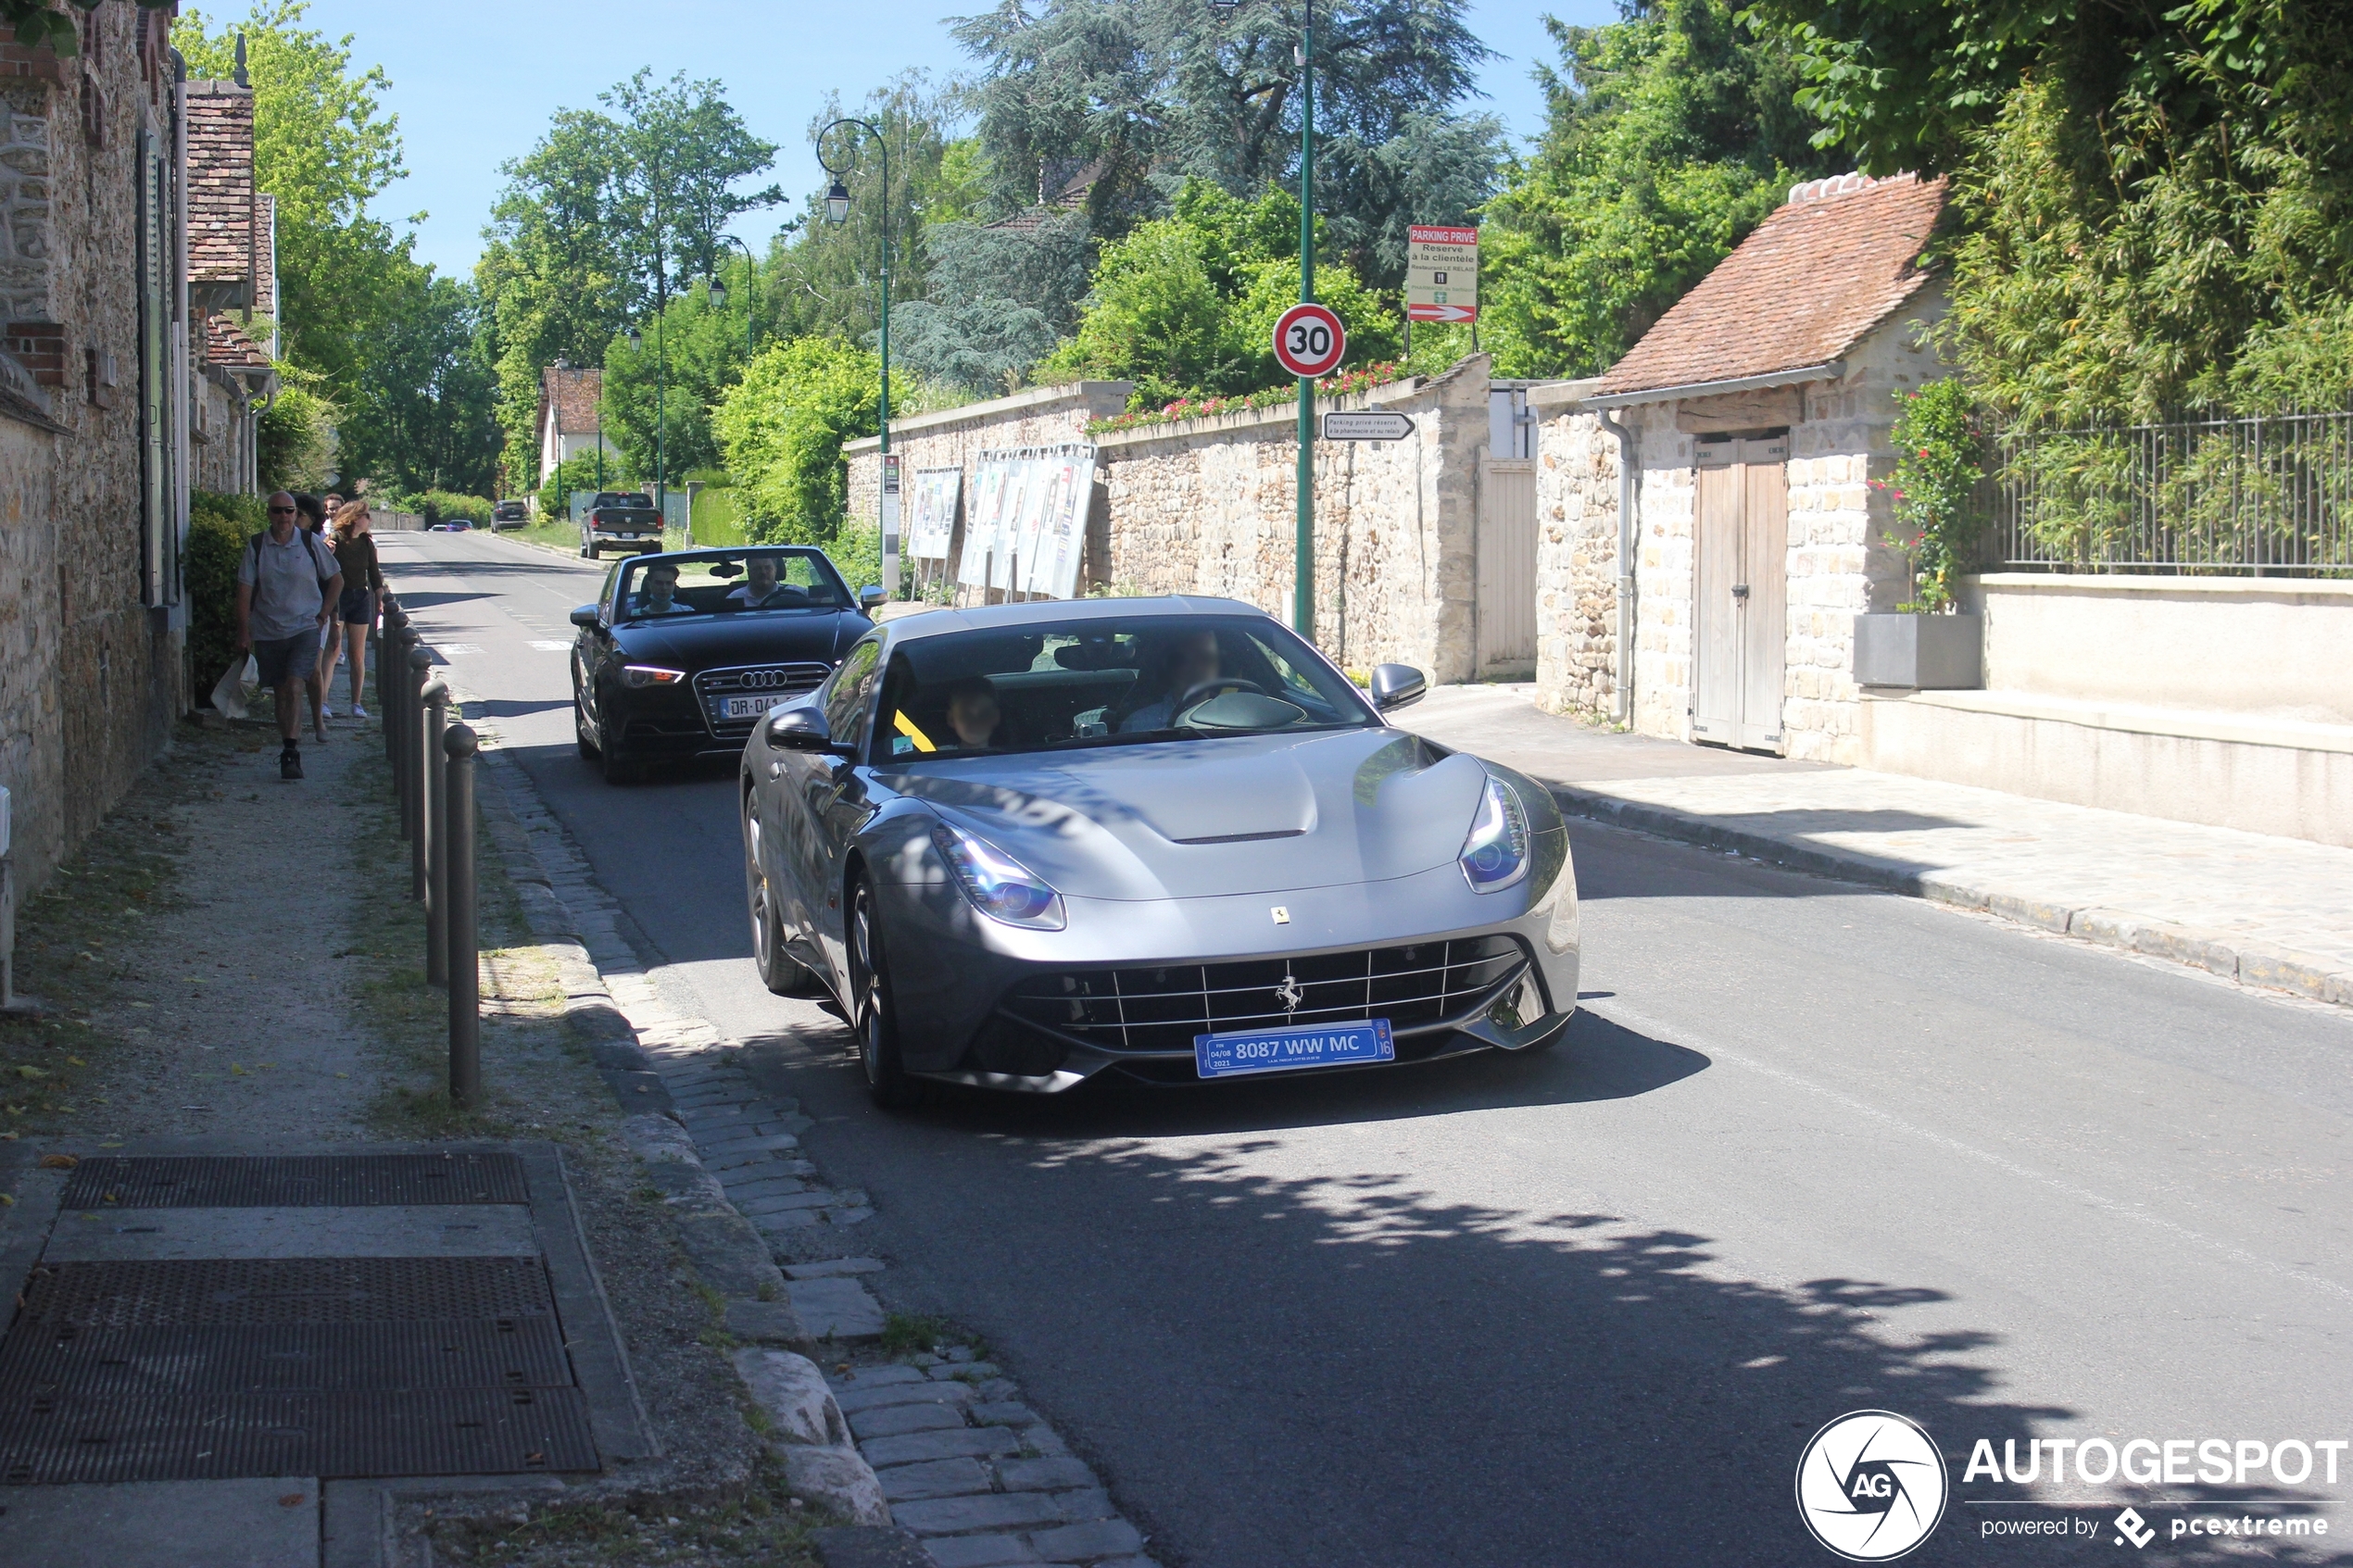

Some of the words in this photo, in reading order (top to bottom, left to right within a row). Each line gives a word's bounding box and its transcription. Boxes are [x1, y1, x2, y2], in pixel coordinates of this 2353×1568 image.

[1412, 230, 1448, 242] PARKING
[1451, 231, 1475, 243] PRIVÉ
[1423, 245, 1464, 253] Reservé
[1432, 254, 1474, 263] clientèle
[1289, 326, 1329, 356] 30
[1328, 419, 1353, 427] Parking
[1235, 1040, 1279, 1060] 8087
[1284, 1036, 1324, 1056] WW
[1329, 1035, 1360, 1052] MC
[1210, 1049, 1231, 1059] 04/08
[1214, 1060, 1230, 1068] 2021
